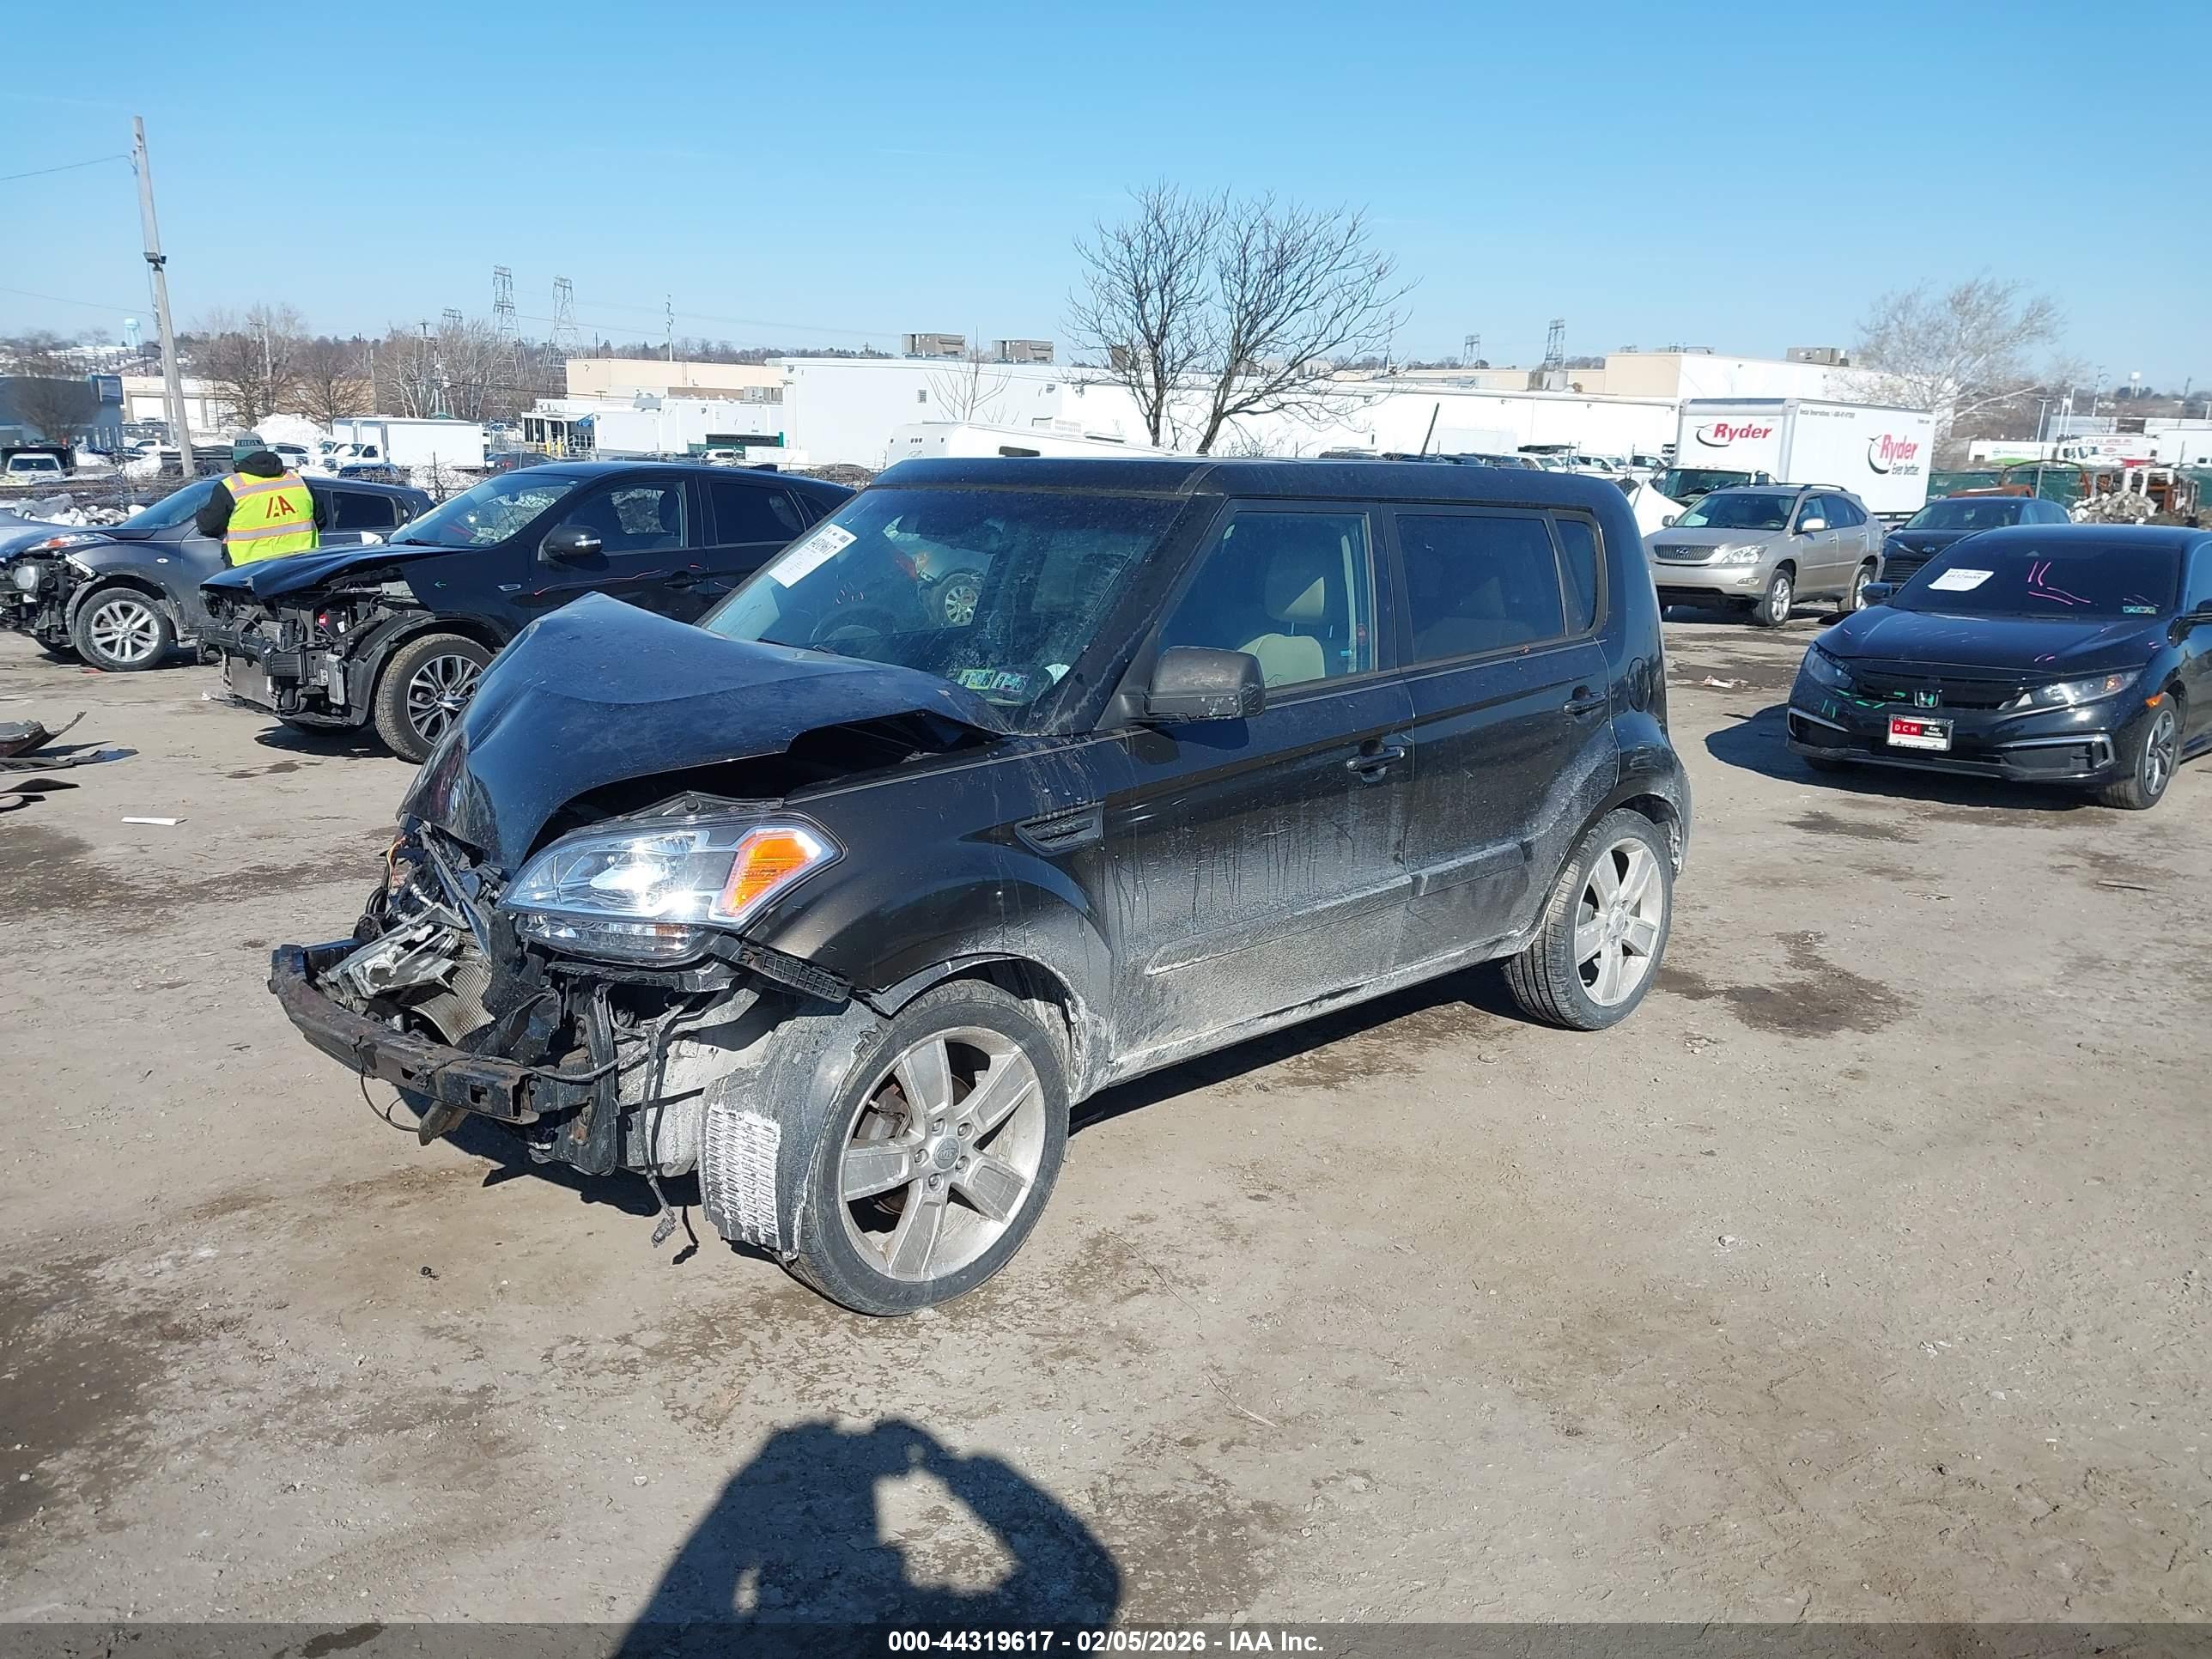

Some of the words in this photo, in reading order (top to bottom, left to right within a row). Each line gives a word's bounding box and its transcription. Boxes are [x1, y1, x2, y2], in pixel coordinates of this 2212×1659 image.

[1713, 423, 1772, 442] Ryder
[1879, 434, 1918, 465] Ryder
[1892, 462, 1904, 475] Ever
[962, 674, 970, 686] 3
[981, 672, 994, 687] 26
[996, 676, 1005, 688] 3
